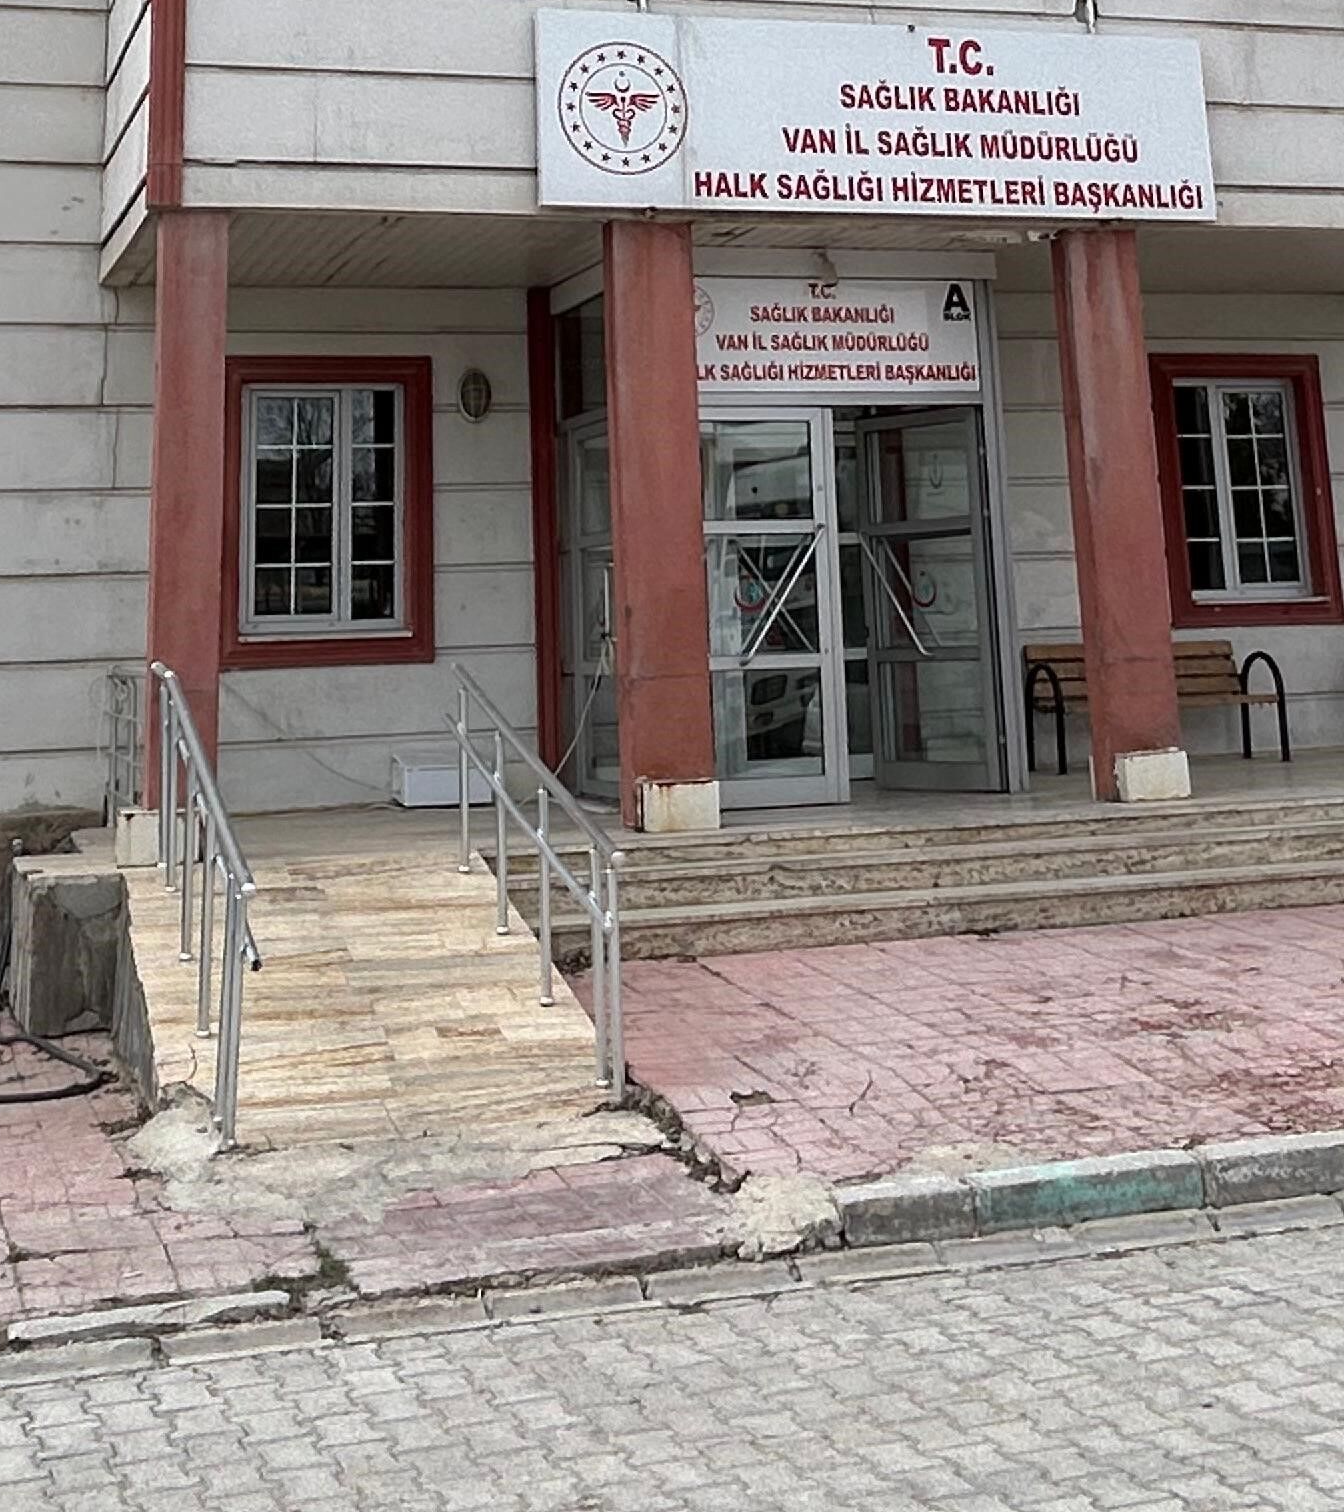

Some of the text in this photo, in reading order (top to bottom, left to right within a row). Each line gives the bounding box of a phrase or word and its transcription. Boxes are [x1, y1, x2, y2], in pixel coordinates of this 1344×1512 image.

[927, 37, 995, 76] T.C.
[840, 79, 1080, 117] SAĞLIK BAKANLIĞI
[782, 123, 1138, 163] VAN İL SAĞLIK MÜDÜRLÜĞÜ
[694, 169, 1204, 214] HALK SAĞLIĞI HİZMETLERİ BAŞKANLIĞI
[750, 302, 895, 323] SAĞLIK BAKANLIĞI
[943, 284, 971, 312] A
[716, 330, 930, 352] VAN İL SAĞLIK MÜDÜRLÜĞÜ
[696, 361, 976, 385] LK SAĞLIĞI HİZMETLERİ BAŞKANLIĞI
